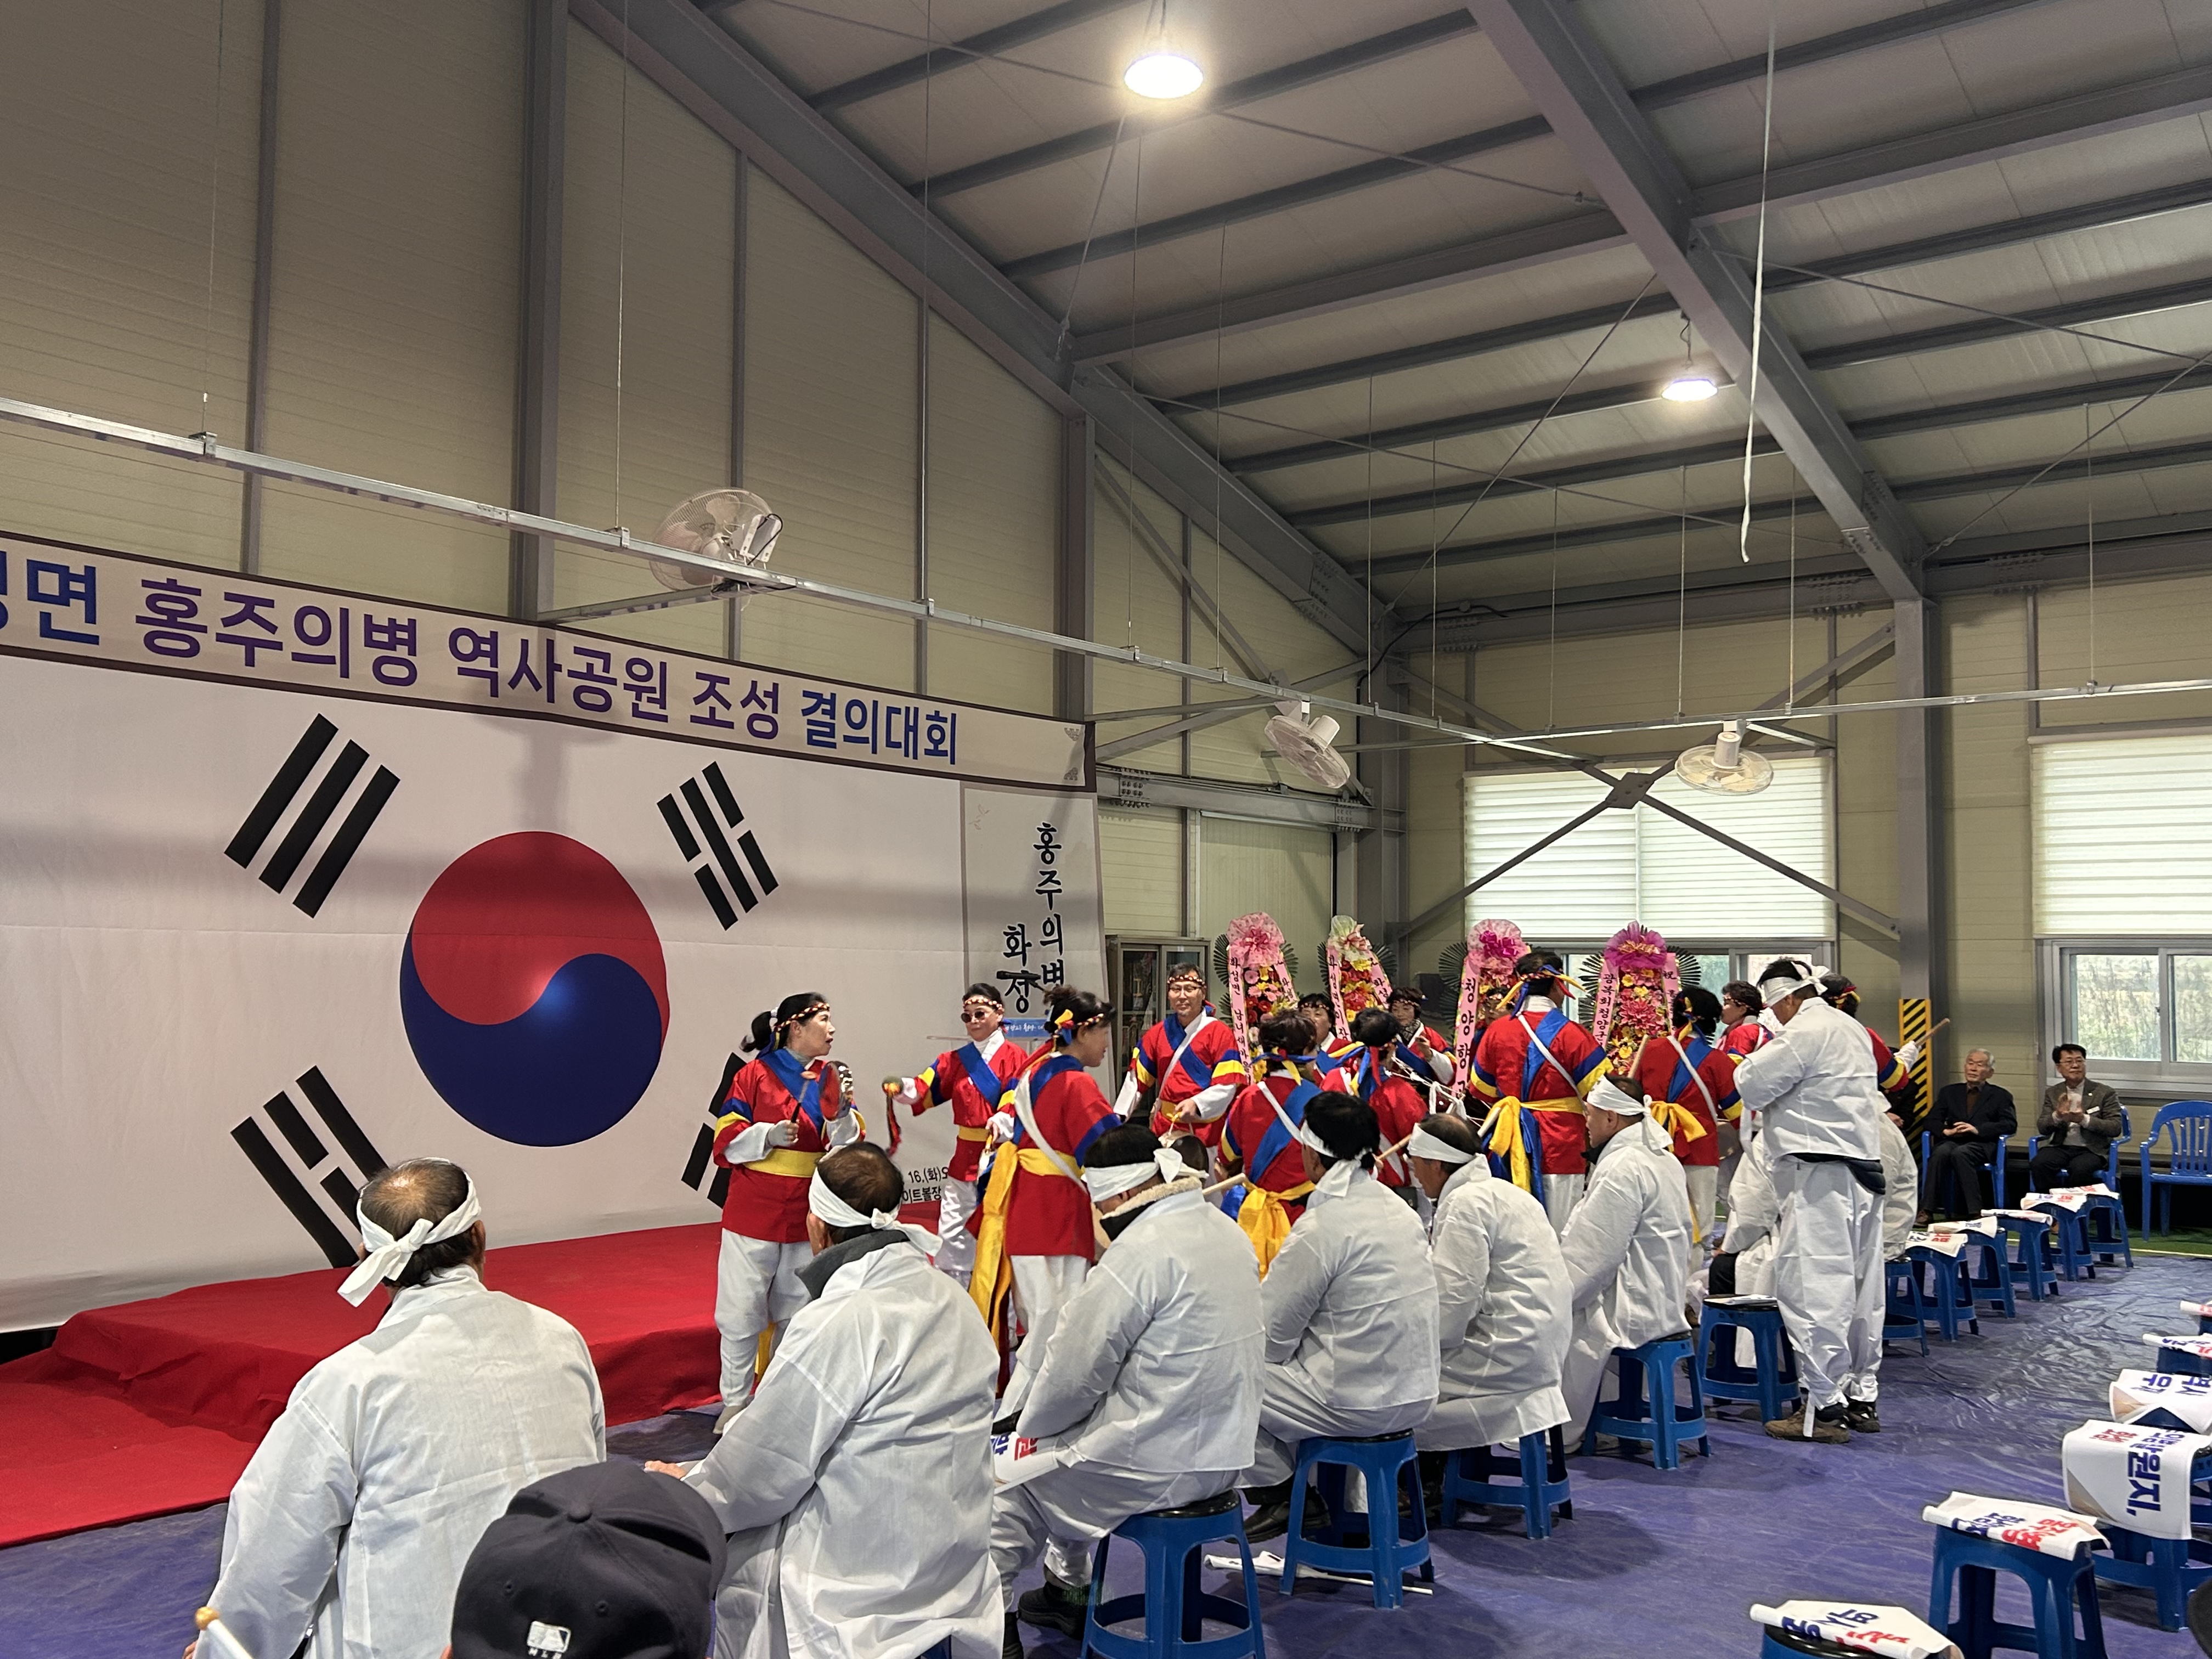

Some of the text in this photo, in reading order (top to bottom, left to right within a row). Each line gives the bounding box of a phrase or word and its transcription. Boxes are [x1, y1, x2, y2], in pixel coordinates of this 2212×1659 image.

[136, 578, 418, 687] 홍주의병
[449, 627, 669, 724] 역사공원
[689, 671, 780, 740] 조성
[800, 690, 957, 765] 결의대회
